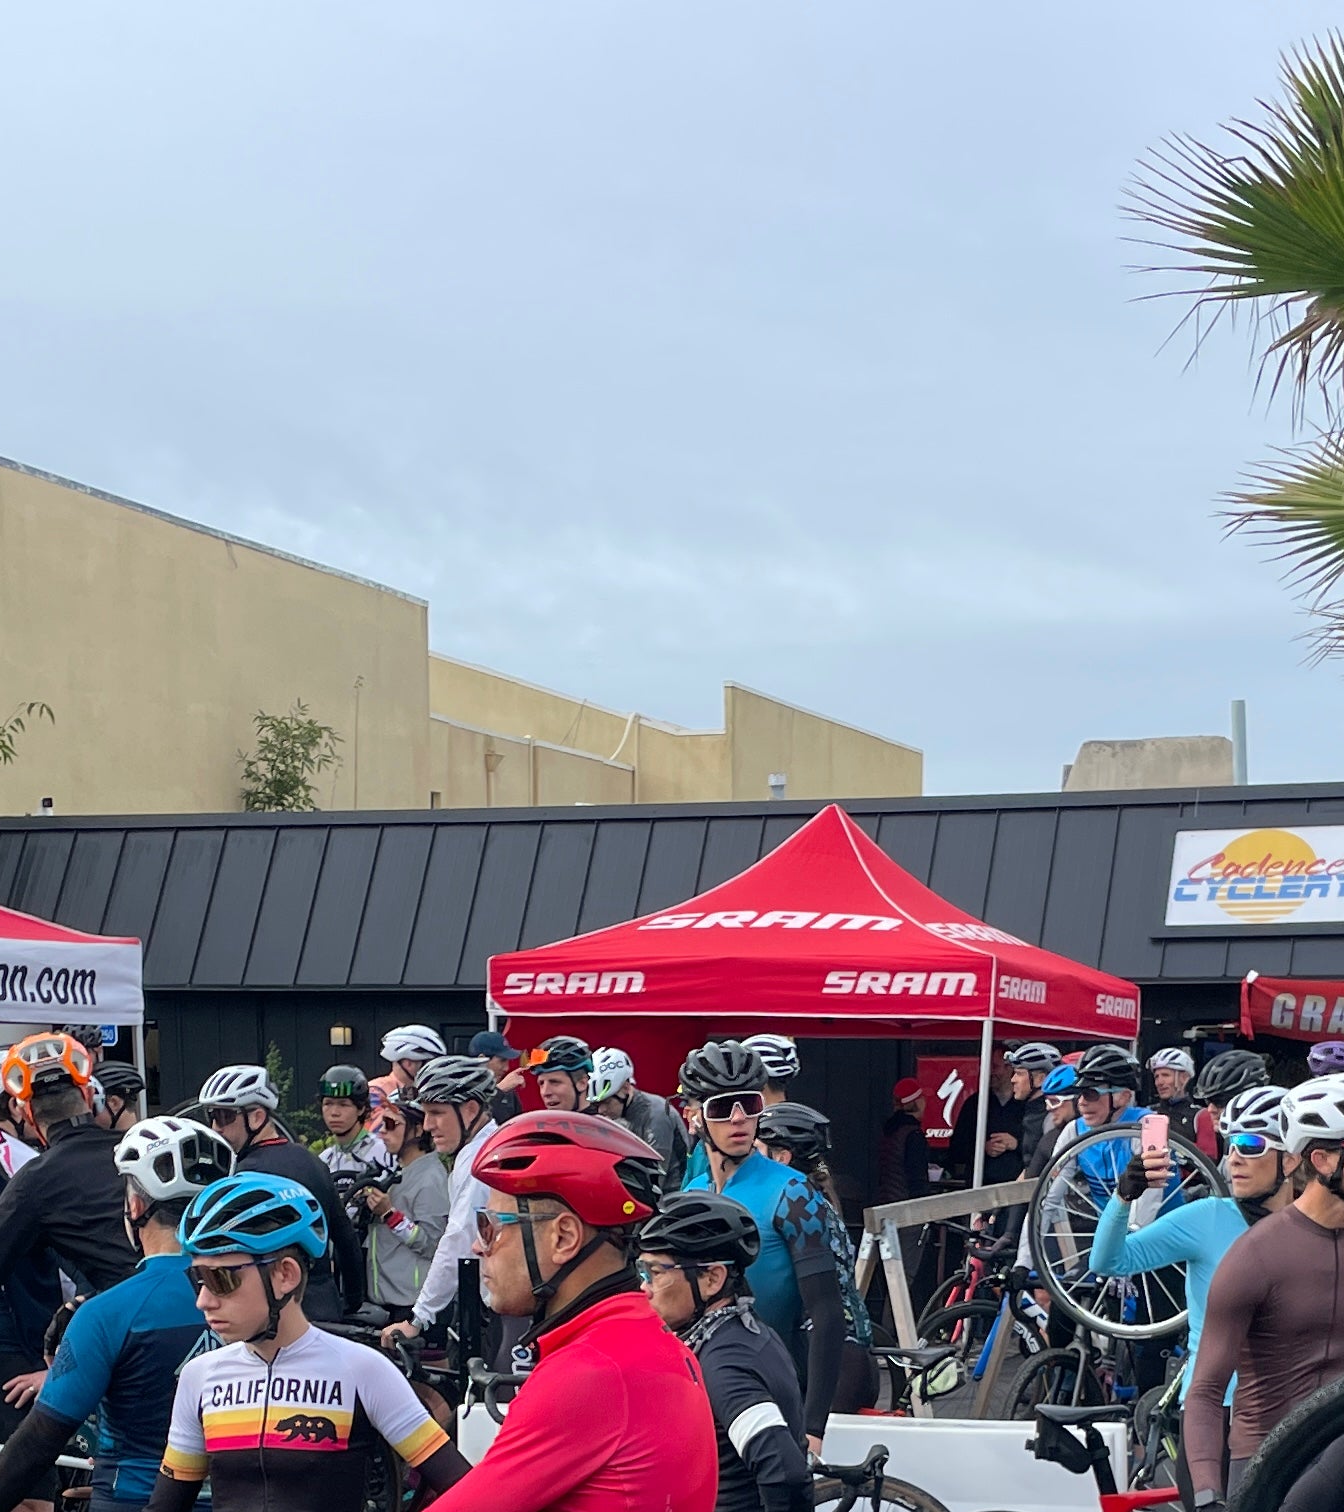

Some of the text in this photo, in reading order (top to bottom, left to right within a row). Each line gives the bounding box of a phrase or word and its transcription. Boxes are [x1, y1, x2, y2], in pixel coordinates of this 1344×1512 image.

[637, 910, 901, 932] SRAM
[928, 922, 1031, 947] SRAM
[502, 970, 646, 995] SRAM
[822, 970, 978, 997] SRAM
[998, 975, 1047, 1005] SRAM
[1096, 993, 1138, 1021] SRAM
[211, 1377, 343, 1407] CALIFORNIA
